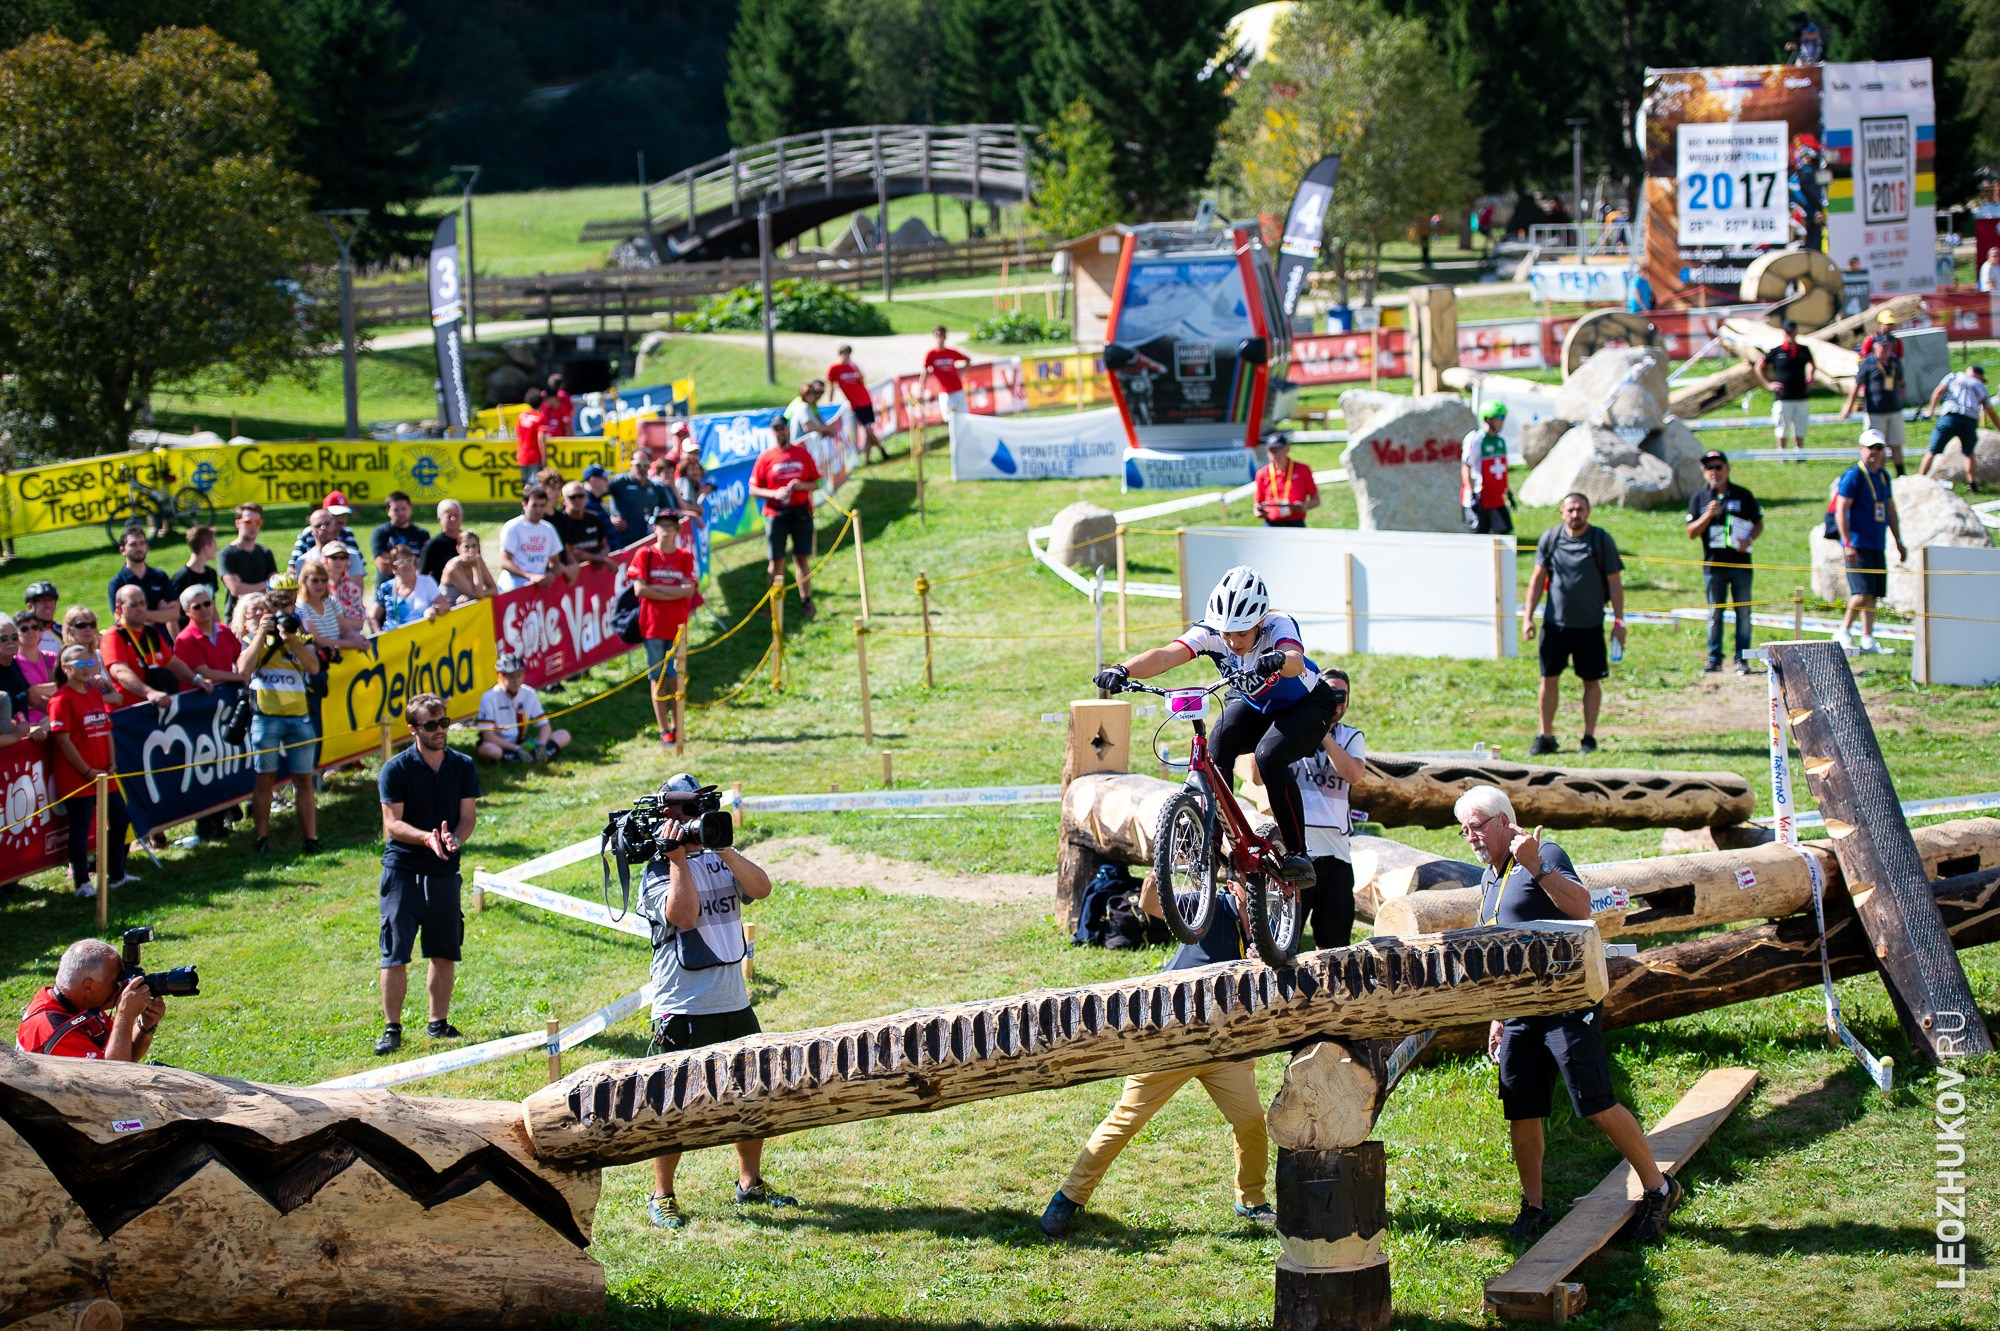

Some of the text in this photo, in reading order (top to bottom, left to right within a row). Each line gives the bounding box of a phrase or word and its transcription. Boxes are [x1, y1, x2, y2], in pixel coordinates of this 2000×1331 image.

[1688, 171, 1777, 210] 2017
[1296, 194, 1322, 235] 4
[436, 256, 458, 299] 3
[238, 445, 389, 473] Casse Rurali
[459, 444, 518, 471] Cass
[19, 471, 95, 500] Casse
[259, 474, 369, 500] Trentine
[561, 586, 601, 662] Val
[346, 627, 474, 731] Melinda
[1306, 769, 1345, 791] HOST
[1774, 755, 1787, 804] TRENTINO
